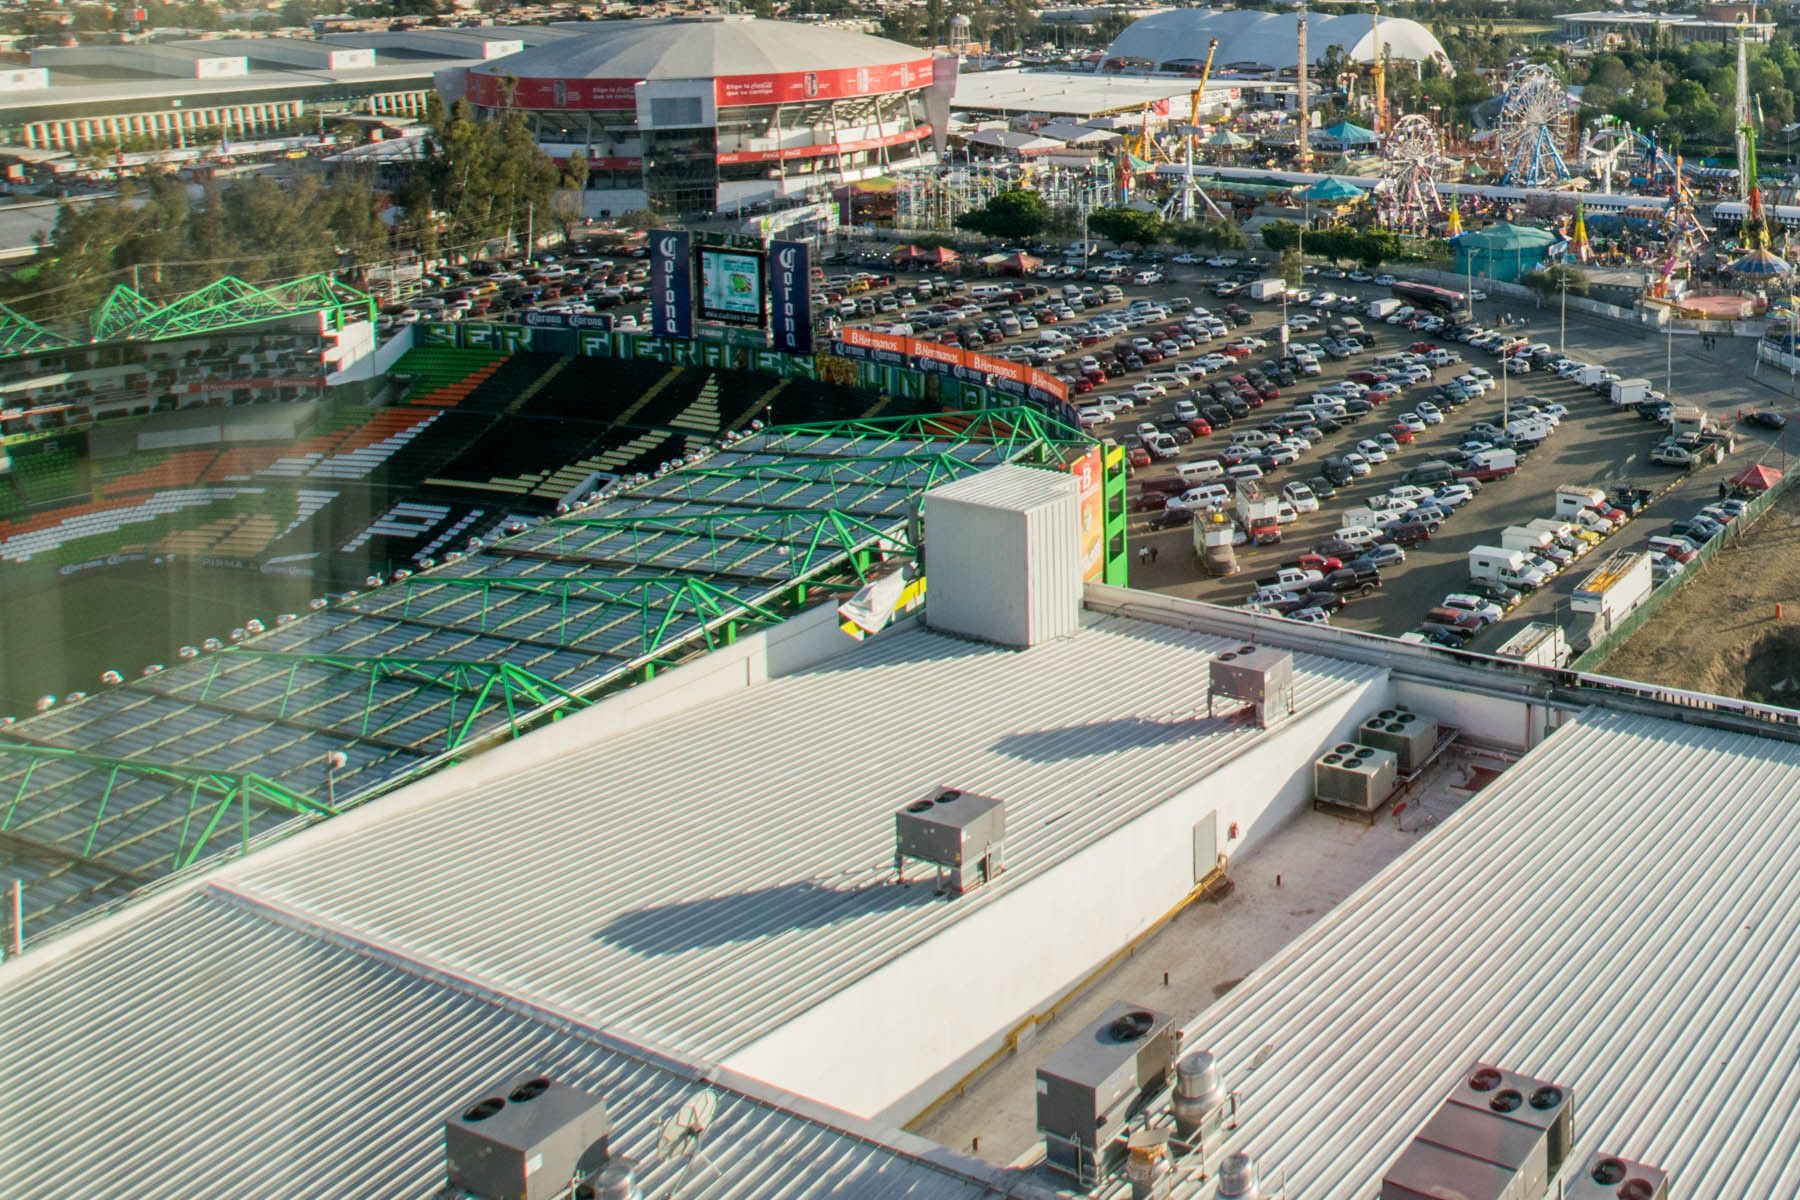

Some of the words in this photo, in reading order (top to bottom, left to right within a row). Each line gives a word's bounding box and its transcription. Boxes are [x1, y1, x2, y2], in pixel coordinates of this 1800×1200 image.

[659, 236, 679, 334] Corona
[779, 247, 797, 347] Corona
[527, 311, 562, 325] Corona
[569, 314, 604, 327] Corona
